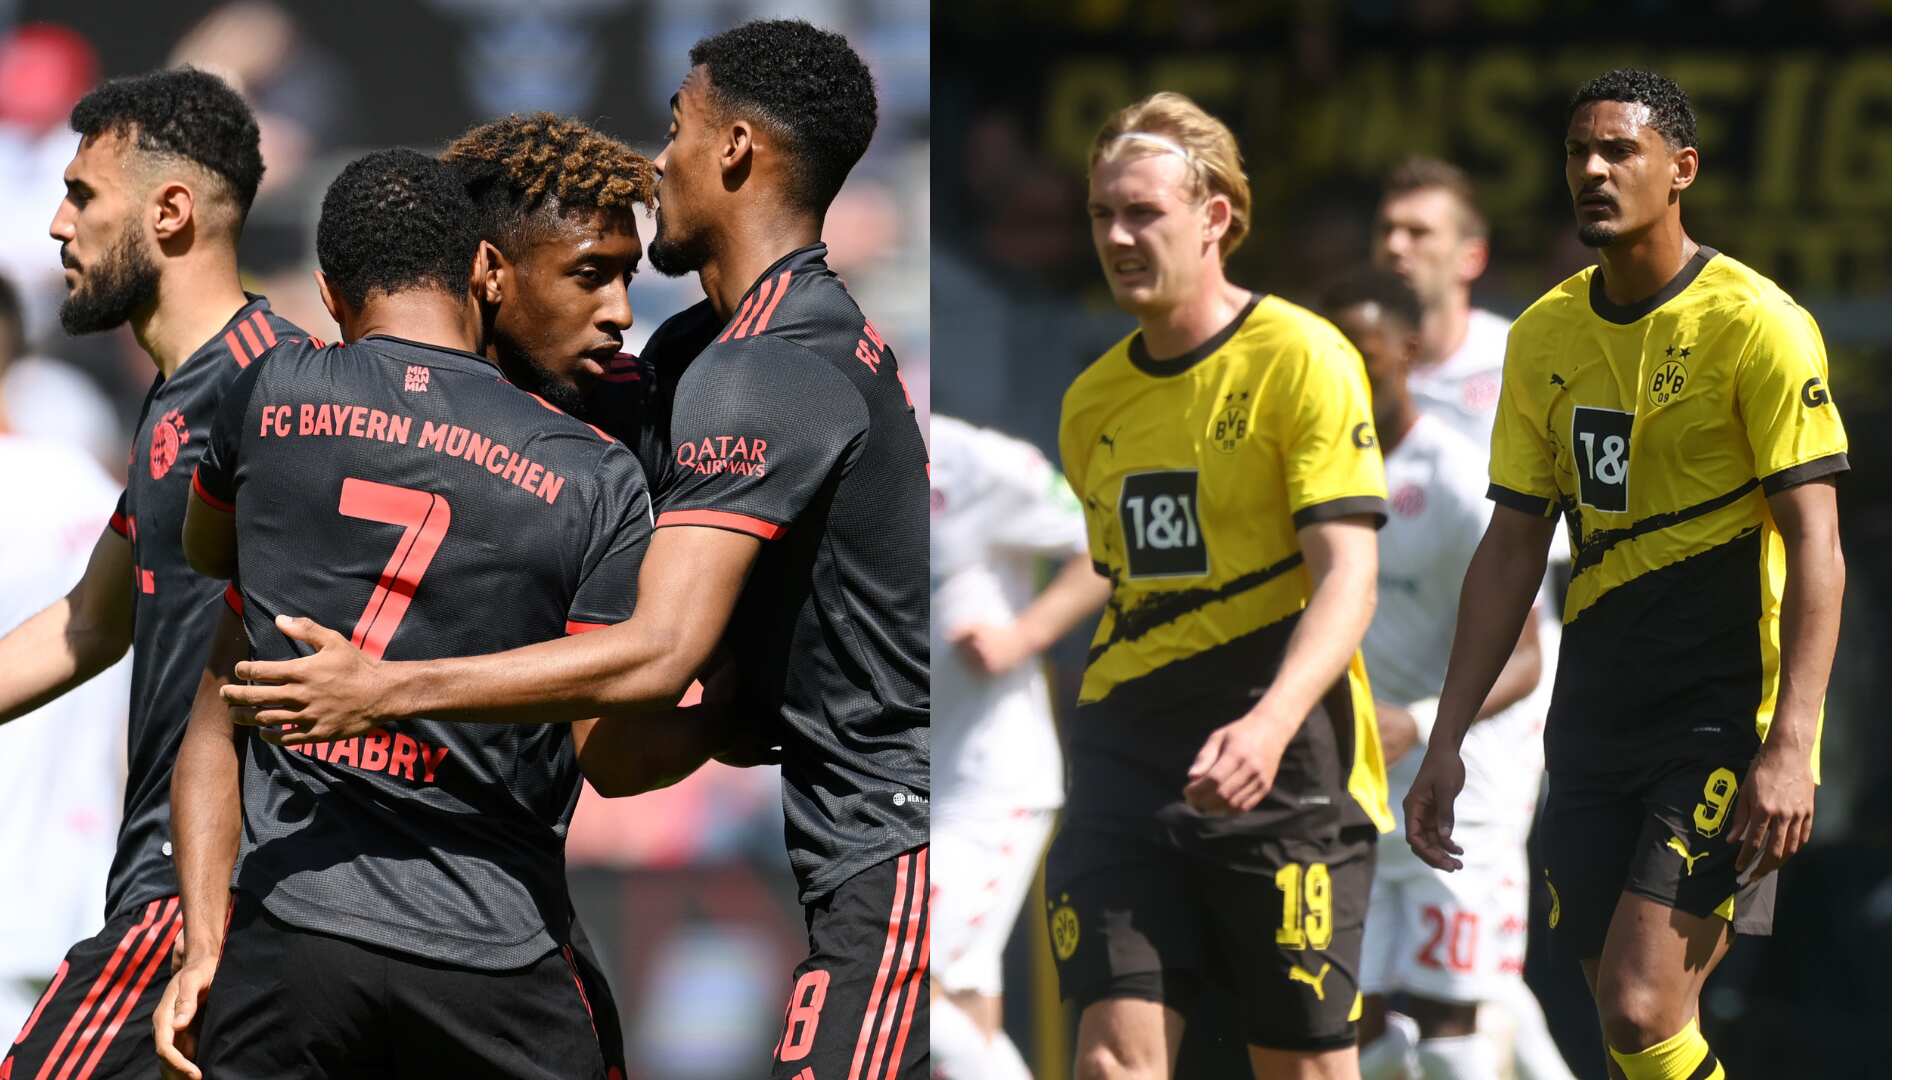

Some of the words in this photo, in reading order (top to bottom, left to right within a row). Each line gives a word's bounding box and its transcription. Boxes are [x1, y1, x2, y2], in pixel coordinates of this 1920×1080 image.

[404, 382, 428, 392] MIA
[405, 374, 429, 384] SAN
[406, 365, 430, 375] MIA
[1652, 364, 1684, 394] BVB
[1214, 409, 1247, 441] BVB
[259, 405, 292, 438] FC
[299, 403, 412, 445] BAYERN
[417, 421, 566, 505] MÜNCHEN
[677, 435, 767, 468] QATAR
[693, 459, 766, 479] AIRWAYS
[1126, 494, 1198, 549] 1&1
[338, 477, 452, 667] 7
[1693, 767, 1739, 838] 9
[1275, 862, 1333, 951] 19
[1416, 904, 1478, 973] 20
[773, 969, 831, 1062] 8
